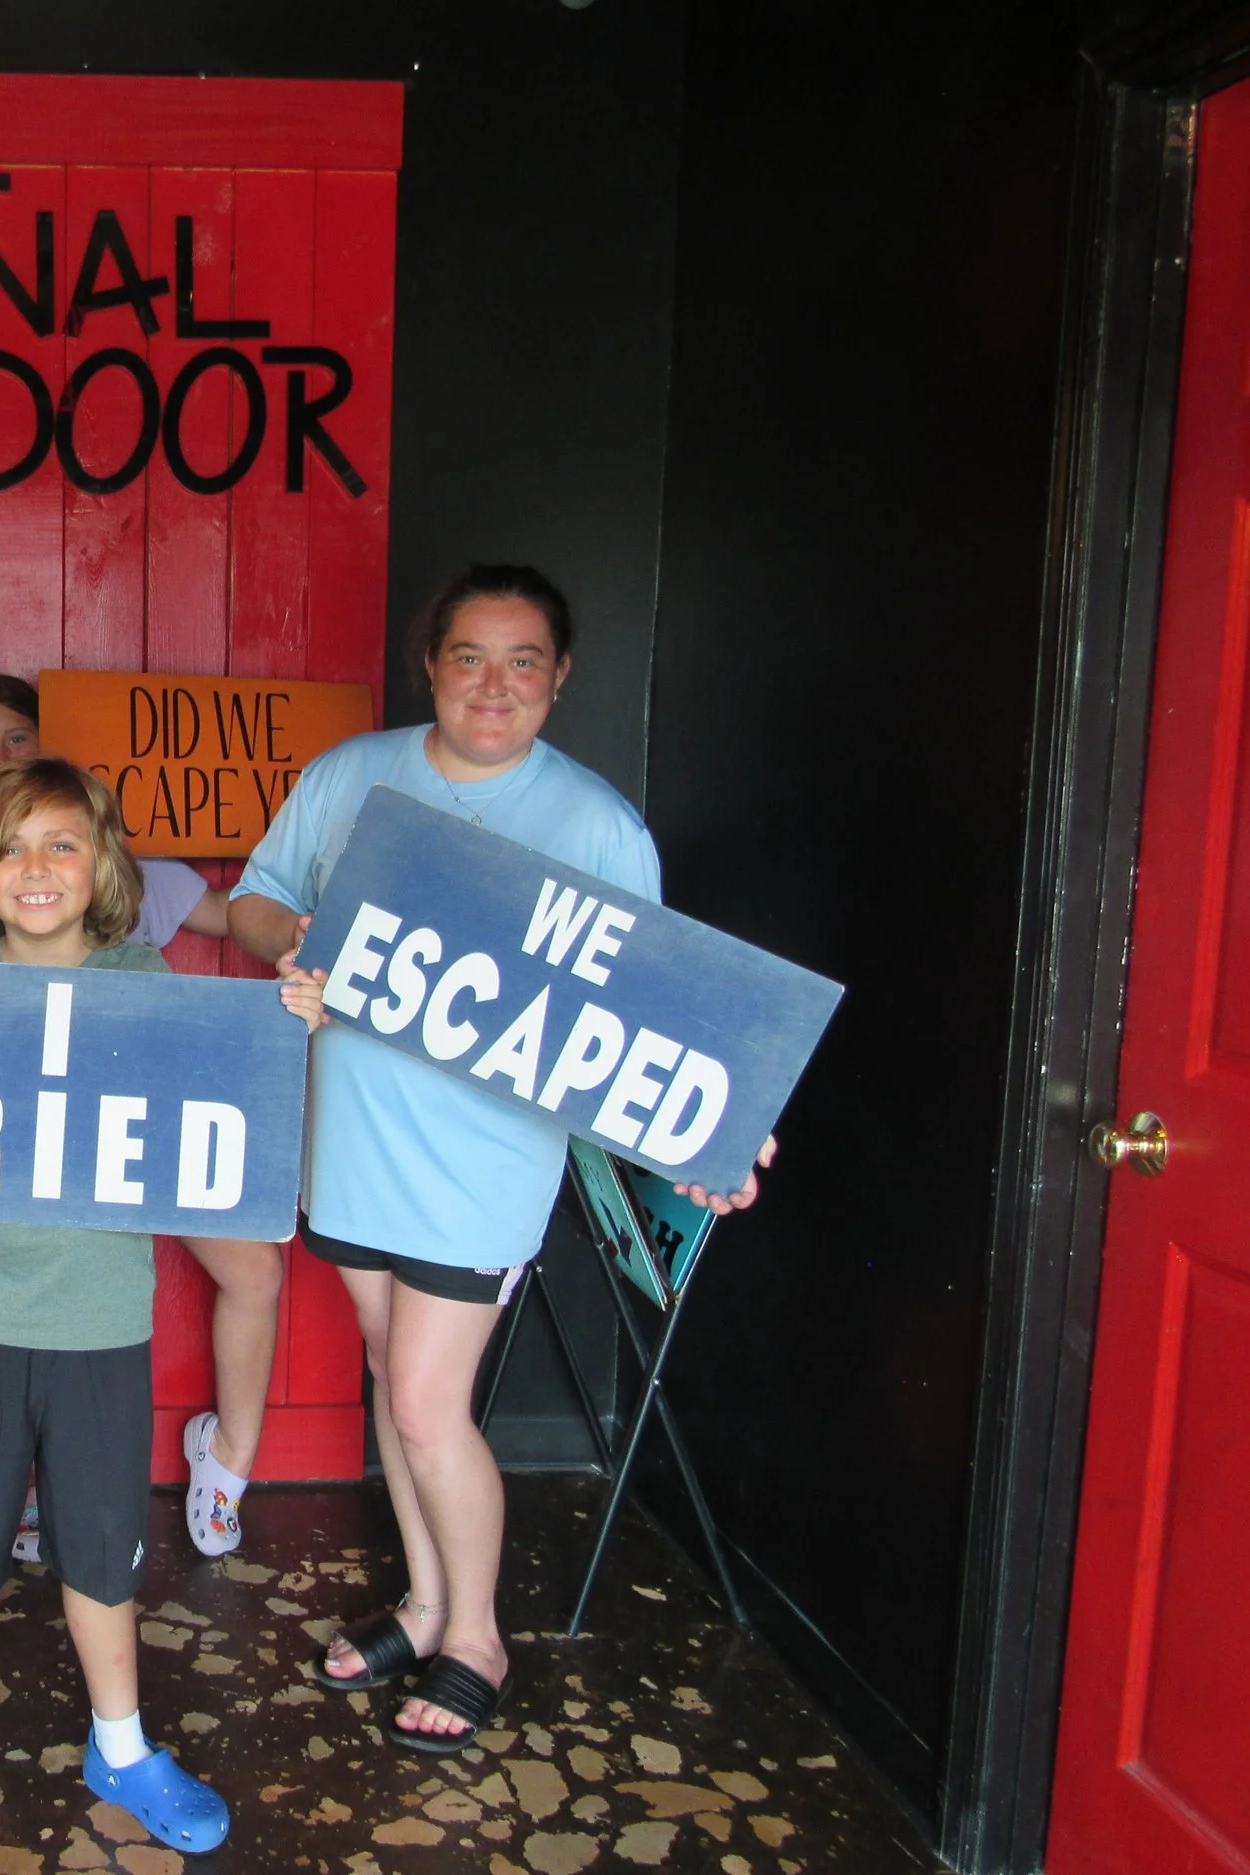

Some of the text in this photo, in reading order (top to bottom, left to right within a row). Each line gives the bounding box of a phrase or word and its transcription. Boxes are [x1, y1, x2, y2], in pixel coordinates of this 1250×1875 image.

[129, 686, 292, 762] DID WE
[89, 764, 241, 838] CAPE
[521, 877, 637, 987] WE
[41, 983, 73, 1077] I
[322, 902, 729, 1166] ESCAPED
